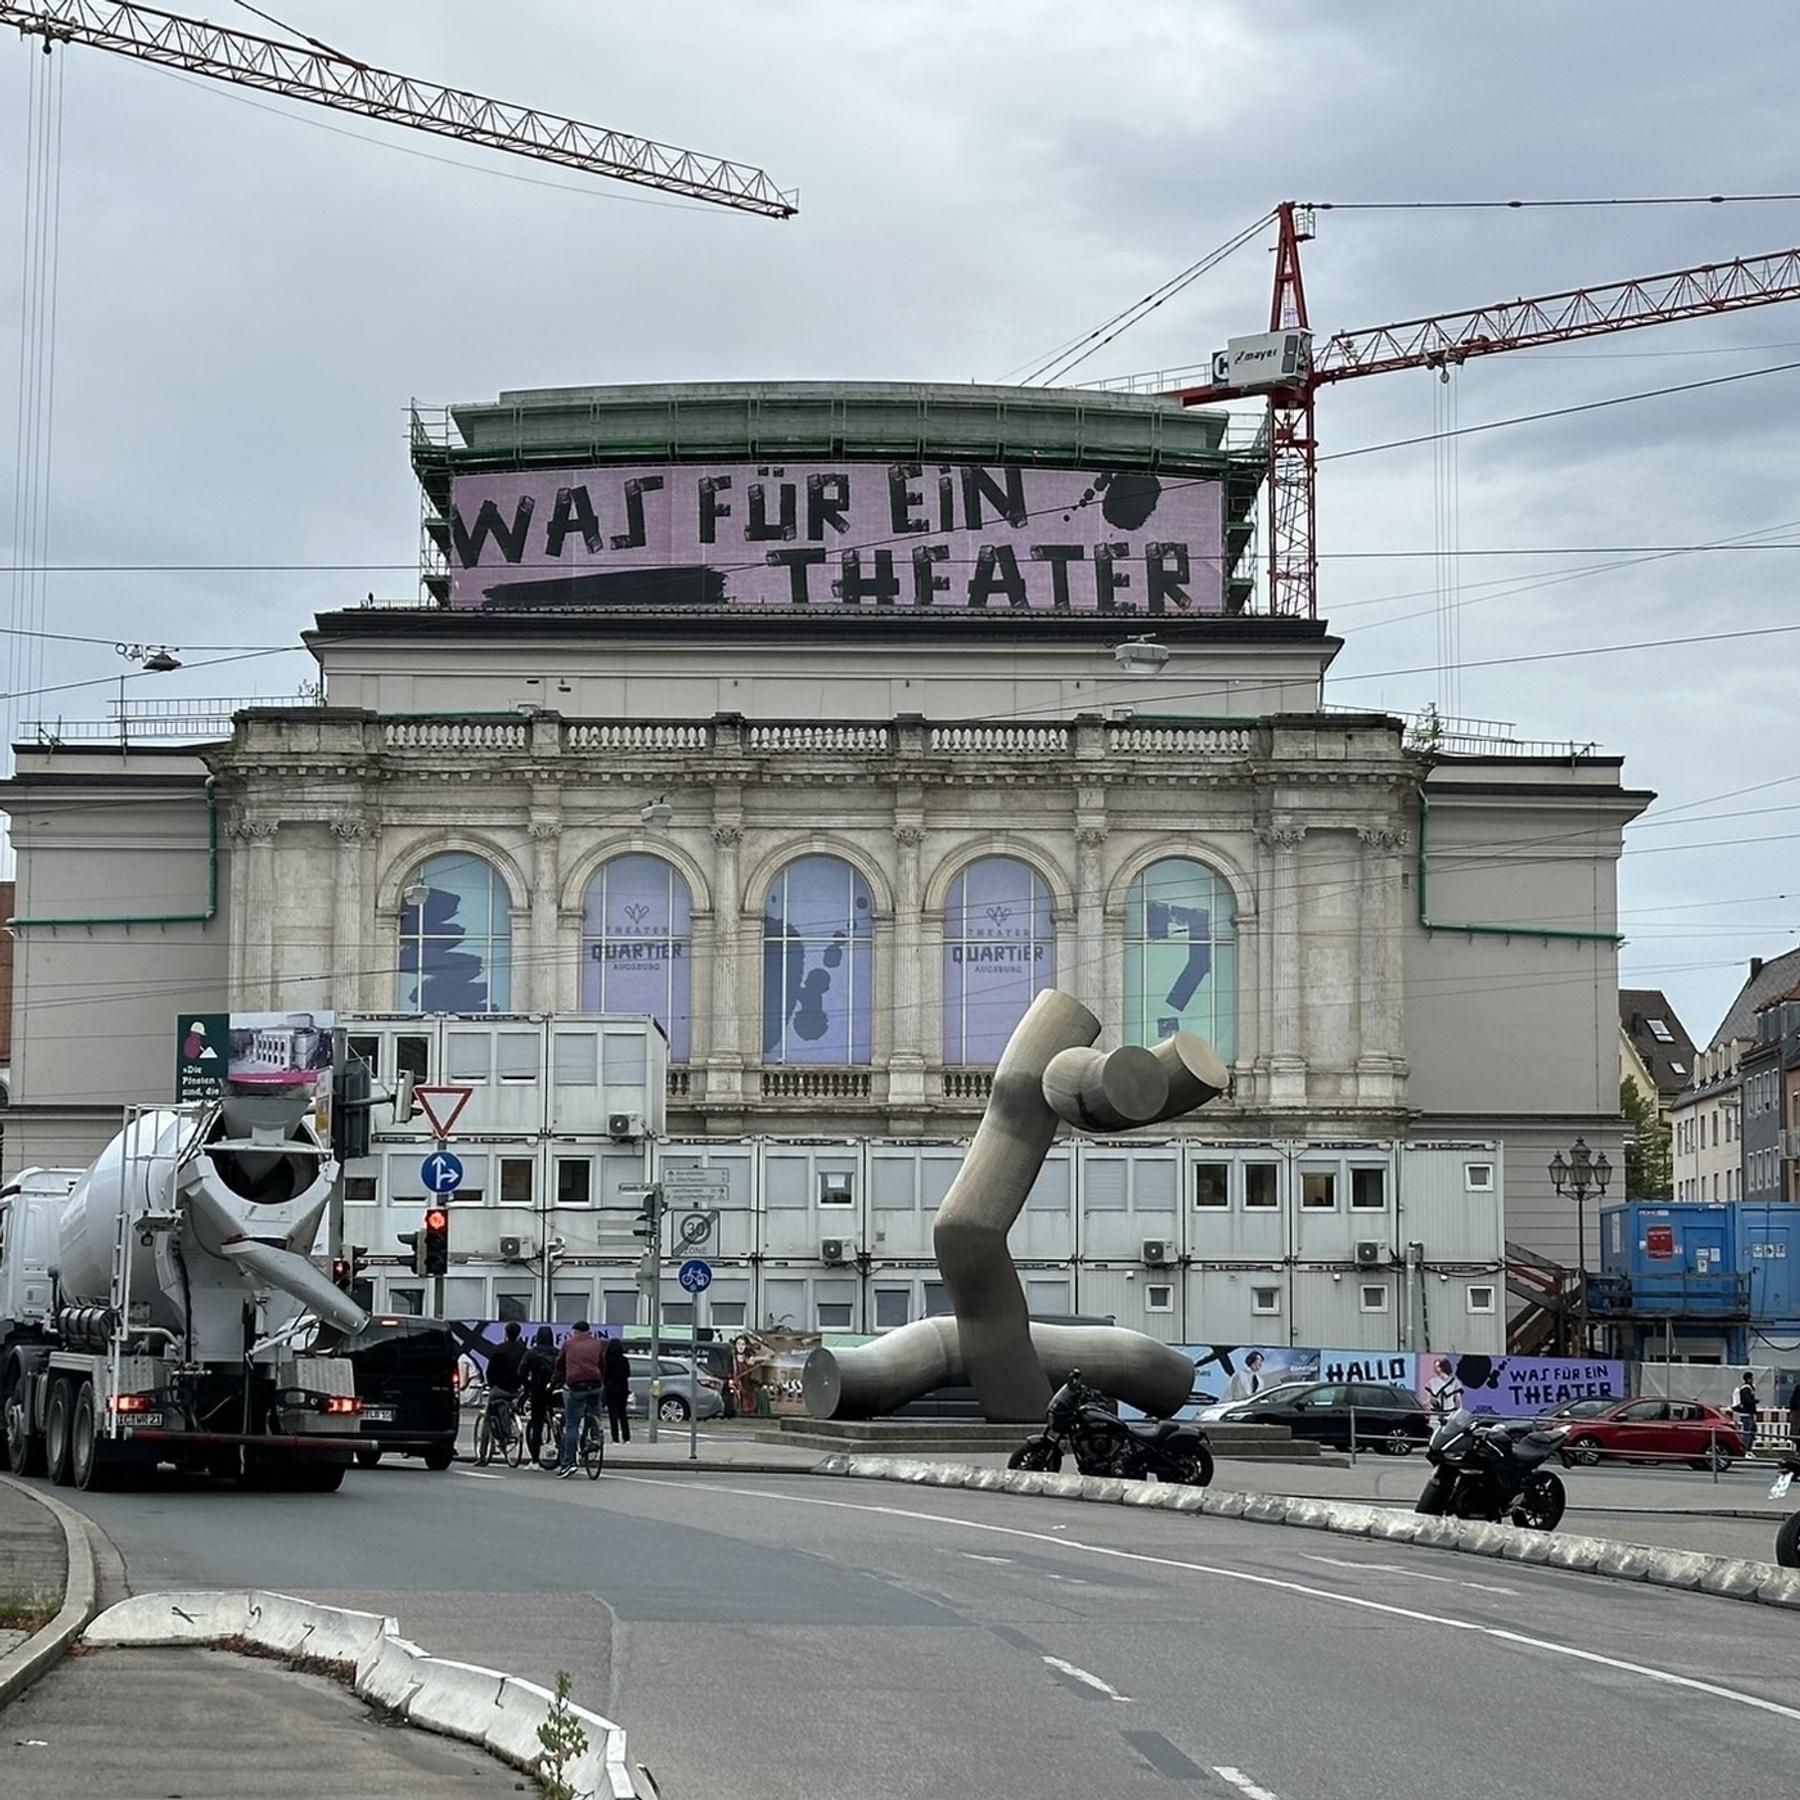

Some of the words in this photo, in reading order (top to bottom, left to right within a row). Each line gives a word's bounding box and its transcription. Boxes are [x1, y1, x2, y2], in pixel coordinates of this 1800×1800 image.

[698, 467, 849, 543] FÜR
[766, 543, 1193, 613] THEATER
[686, 1222, 705, 1236] 30
[1325, 1358, 1406, 1382] HALLO
[1509, 1367, 1550, 1383] WAS
[1554, 1366, 1580, 1380] FÜR
[1585, 1365, 1608, 1379] EIN
[1508, 1382, 1611, 1405] THEATER
